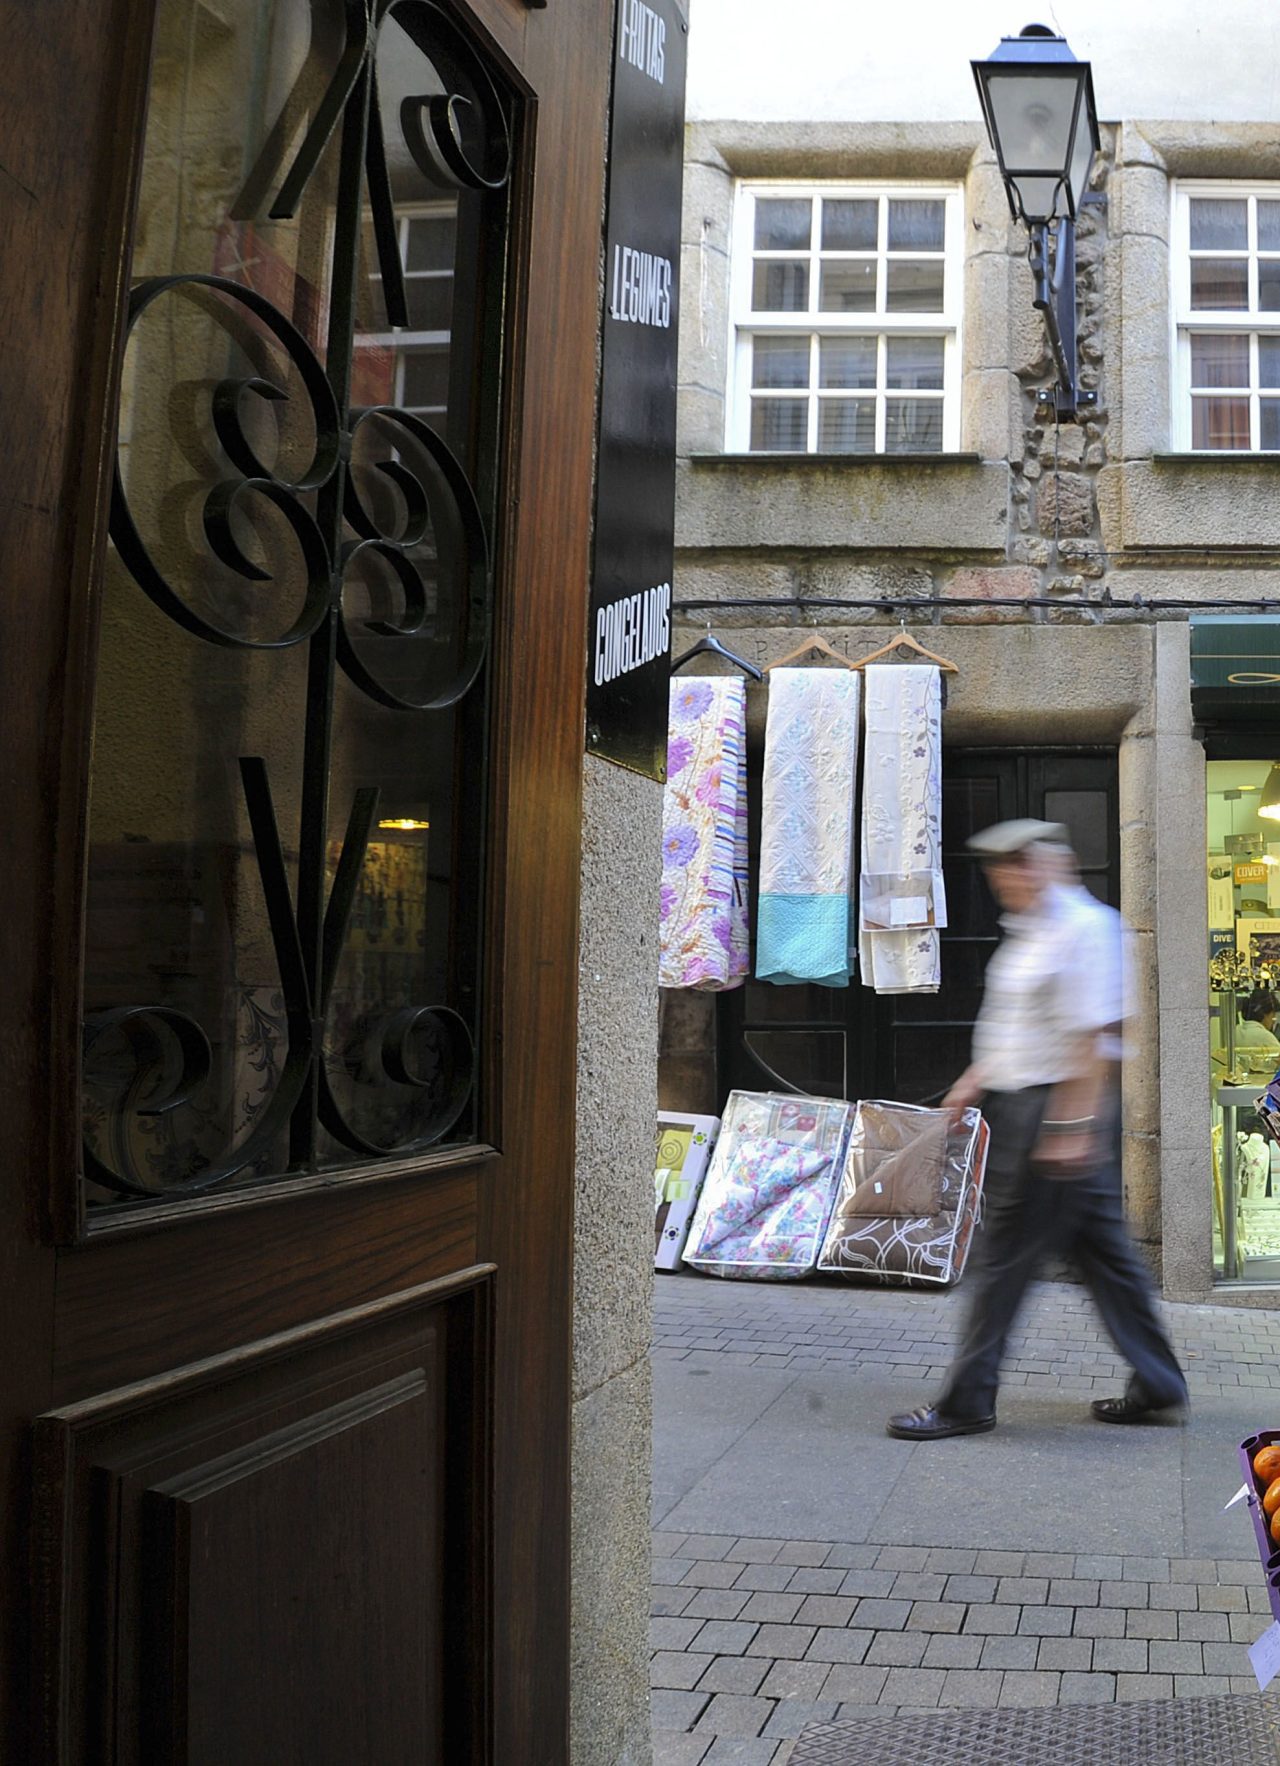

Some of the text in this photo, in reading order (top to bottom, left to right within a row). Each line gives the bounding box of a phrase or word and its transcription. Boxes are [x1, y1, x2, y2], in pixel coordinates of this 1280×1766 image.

[620, 0, 666, 85] FRUTAS
[612, 244, 672, 328] LEGUMES
[595, 583, 670, 686] CONGELADOS
[1236, 865, 1265, 877] COVER
